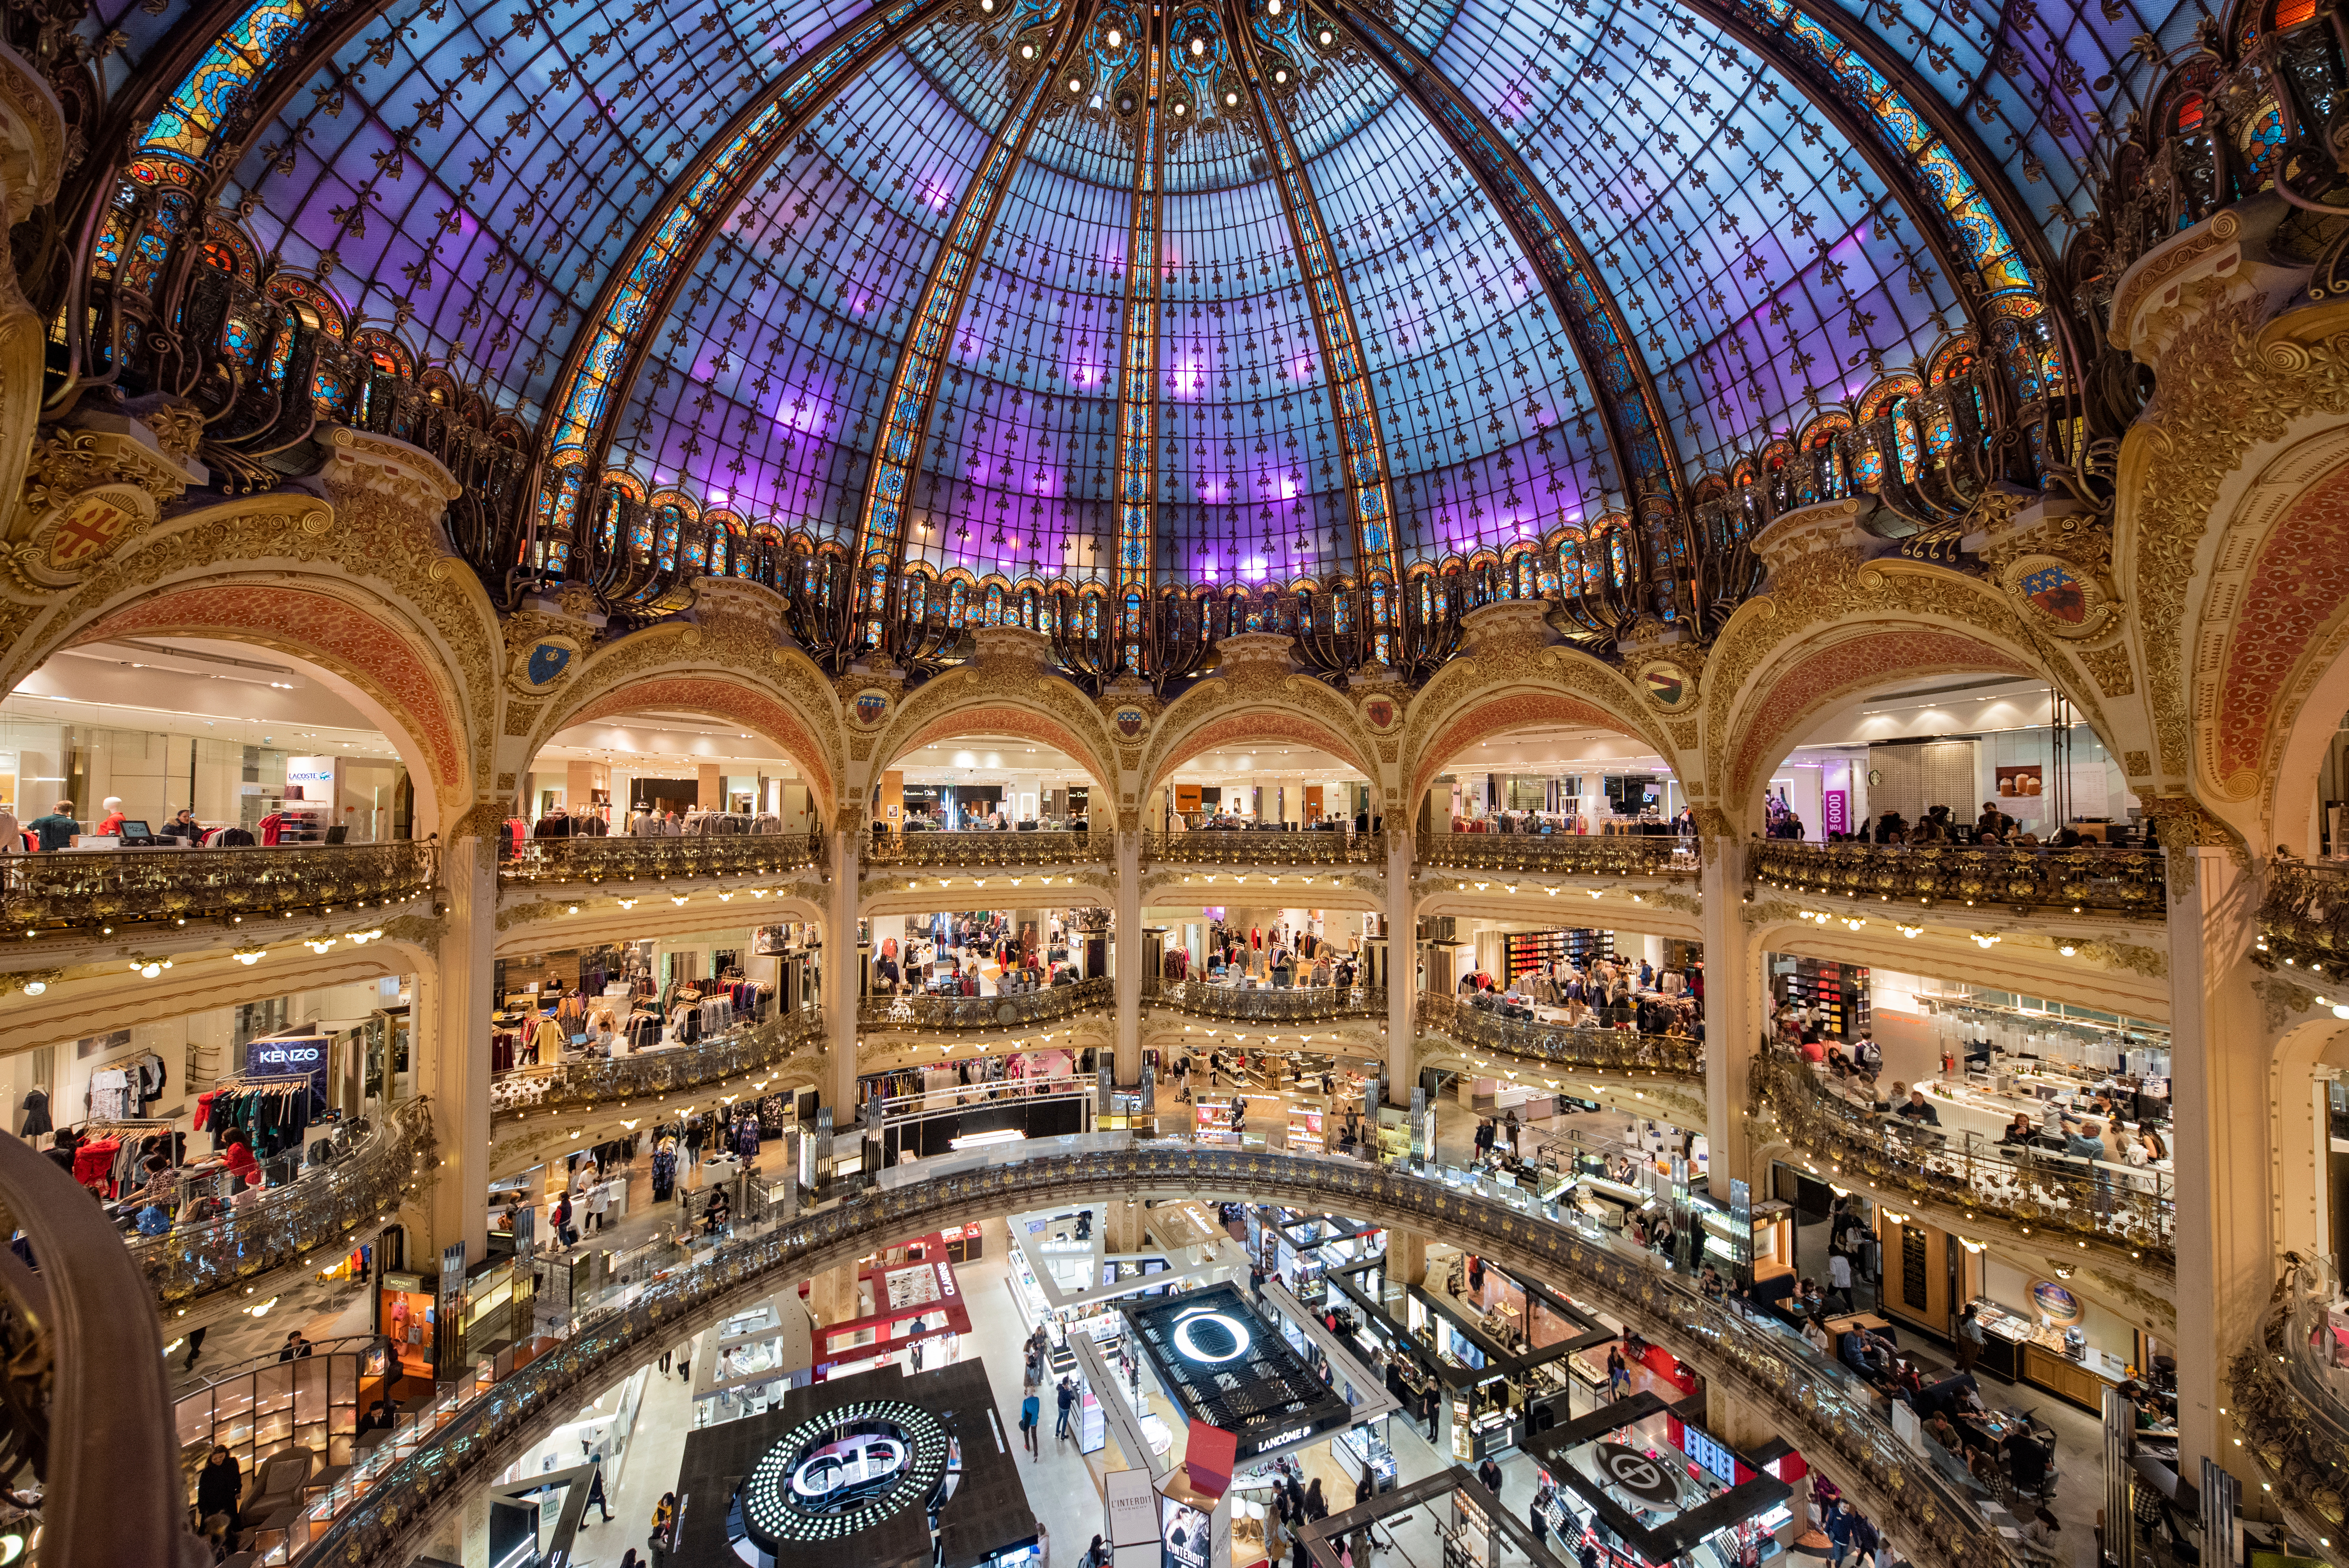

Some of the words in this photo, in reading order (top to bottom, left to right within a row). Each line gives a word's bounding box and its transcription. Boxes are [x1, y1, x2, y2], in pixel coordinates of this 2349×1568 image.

[1829, 795, 1841, 823] GOOD
[1904, 1018, 1929, 1027] COUP
[260, 1048, 319, 1063] KENZO
[963, 1102, 987, 1113] LOUIS
[991, 1098, 1026, 1108] VUITTON
[1184, 1206, 1213, 1234] Sulwhasoo
[937, 1261, 955, 1296] CLARINS
[906, 1334, 943, 1349] CLARINS
[1258, 1428, 1302, 1452] LANCÔME
[793, 1438, 905, 1497] CD
[1111, 1495, 1152, 1508] L'INTERDIT
[1166, 1541, 1205, 1568] L'INTERDIT
